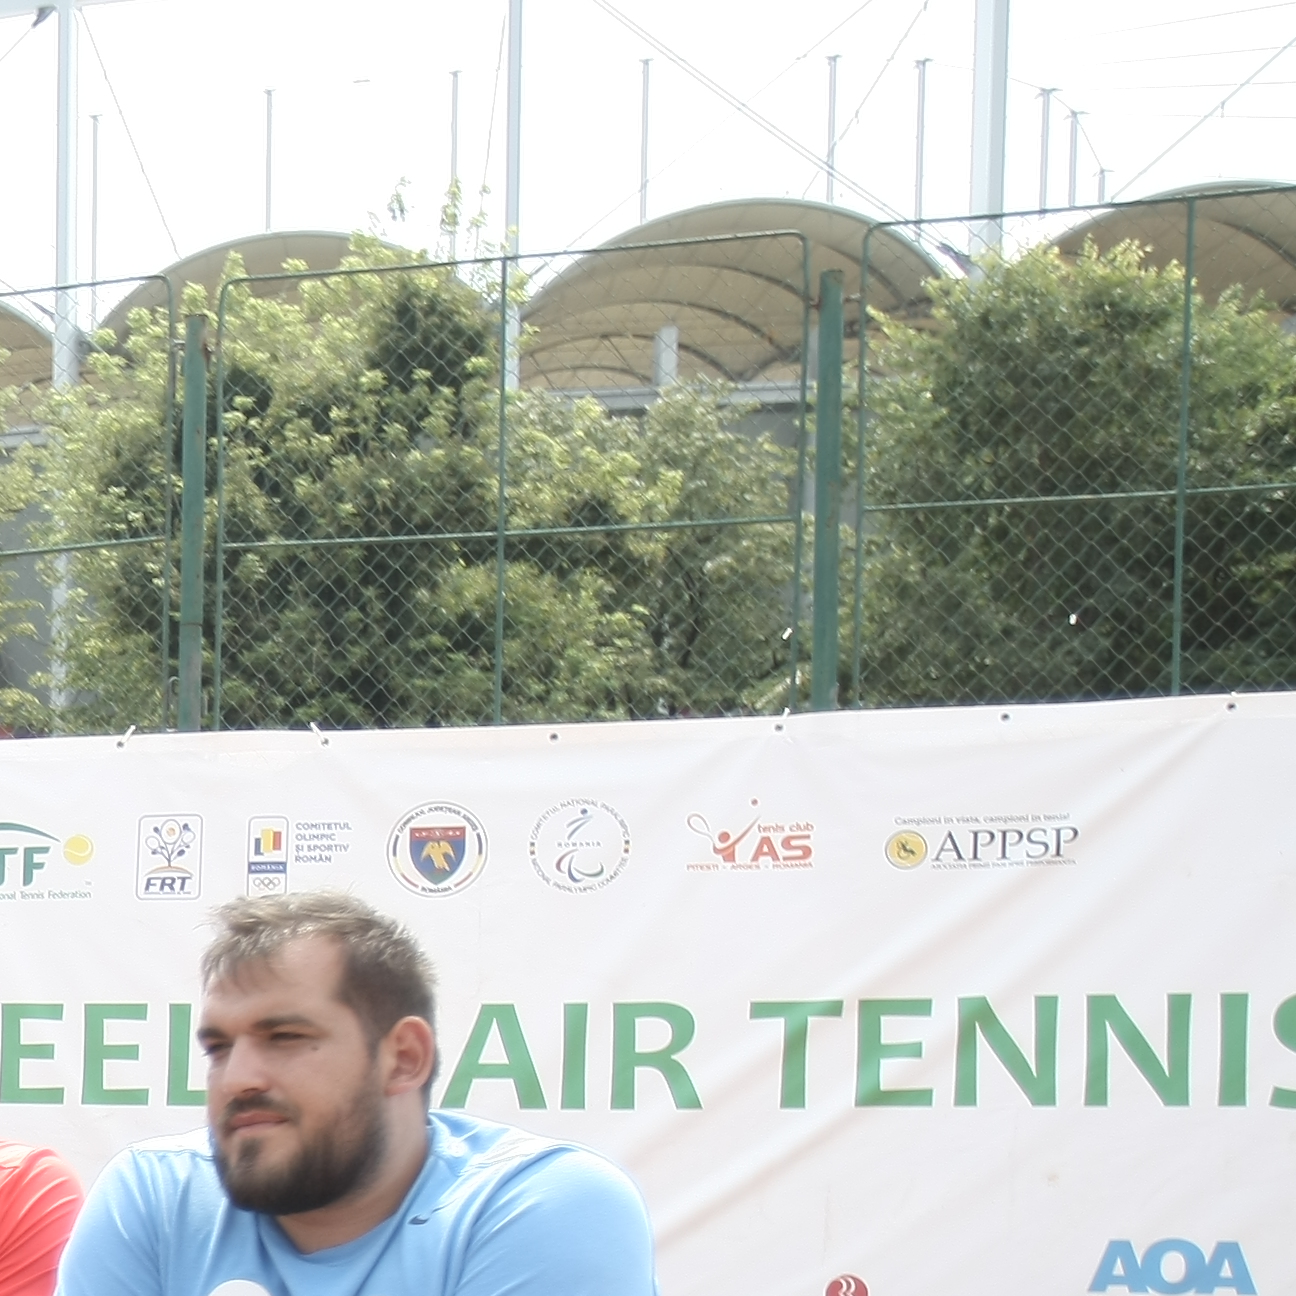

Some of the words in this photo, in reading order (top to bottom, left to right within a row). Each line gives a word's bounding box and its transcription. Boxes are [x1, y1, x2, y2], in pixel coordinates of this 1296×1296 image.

[295, 822, 352, 831] COMITETUL
[789, 822, 814, 832] club
[295, 833, 337, 842] OLIMPIC
[307, 844, 350, 852] SPORTIV
[931, 826, 1079, 862] APPSP
[144, 876, 193, 892] FRT
[19, 890, 45, 899] Tennis
[47, 889, 92, 899] Federation
[1088, 1238, 1258, 1296] AOA
